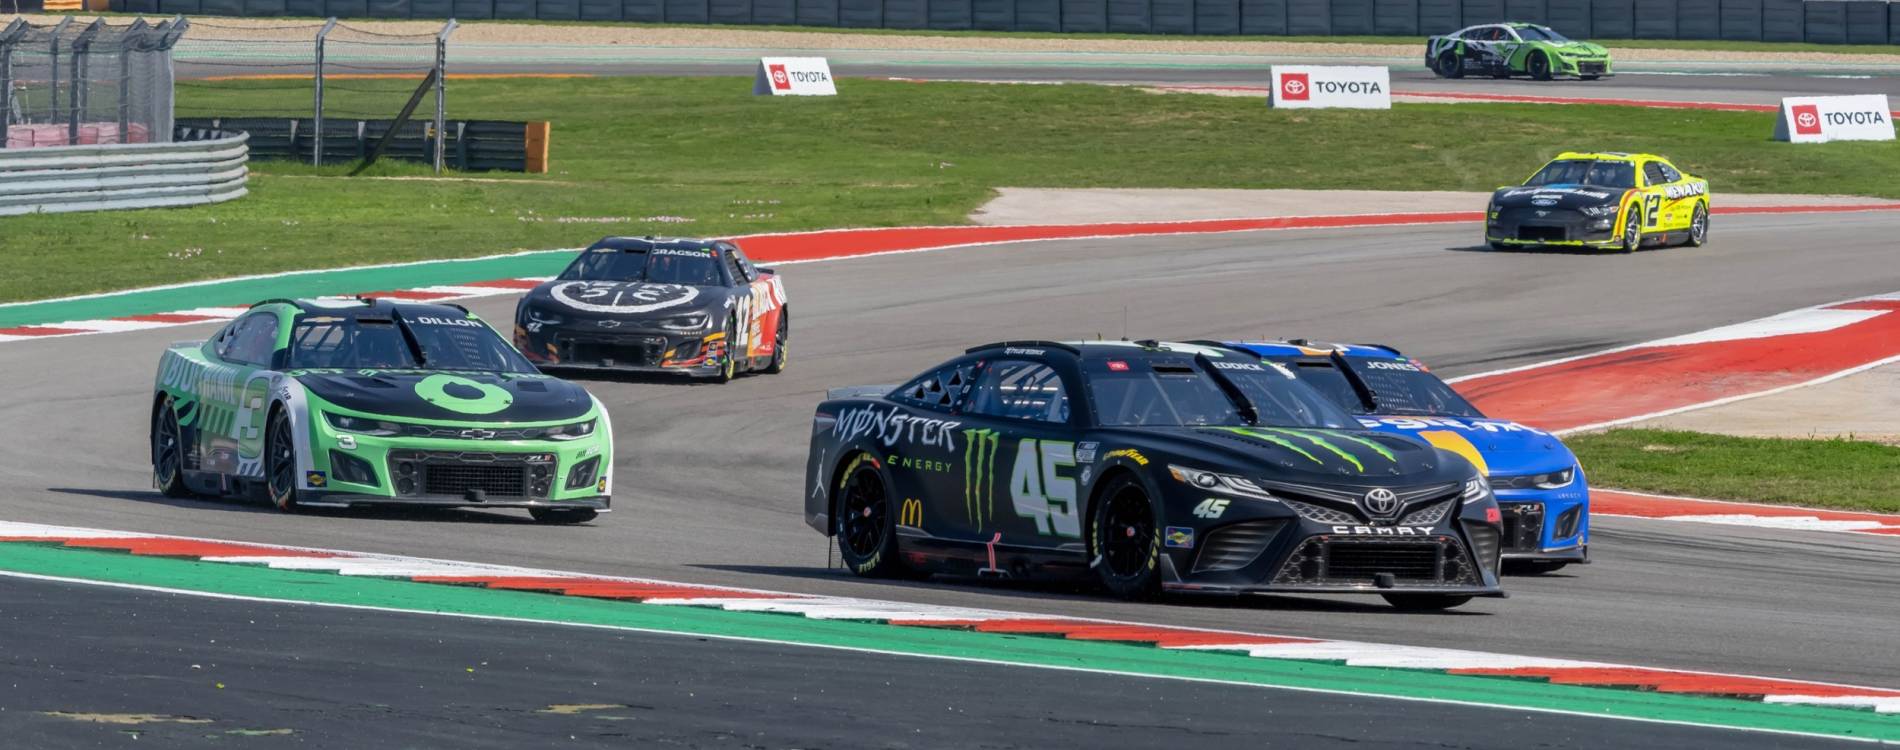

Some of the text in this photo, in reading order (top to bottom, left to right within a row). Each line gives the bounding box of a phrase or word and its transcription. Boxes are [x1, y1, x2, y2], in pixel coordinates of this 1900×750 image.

[1503, 44, 1518, 66] 7
[791, 71, 828, 83] TOYOTA
[1315, 81, 1381, 94] TOYOTA
[1824, 111, 1885, 126] TOYOTA
[1644, 194, 1661, 227] 12
[652, 248, 711, 258] GRAGSON
[418, 316, 483, 328] DILLON
[1211, 361, 1265, 371] EDDICK
[1367, 361, 1419, 372] JONES
[238, 370, 269, 463] 3
[336, 434, 357, 450] 3
[887, 454, 953, 473] ENERGY
[1010, 438, 1081, 538] 45
[1193, 498, 1231, 519] 45
